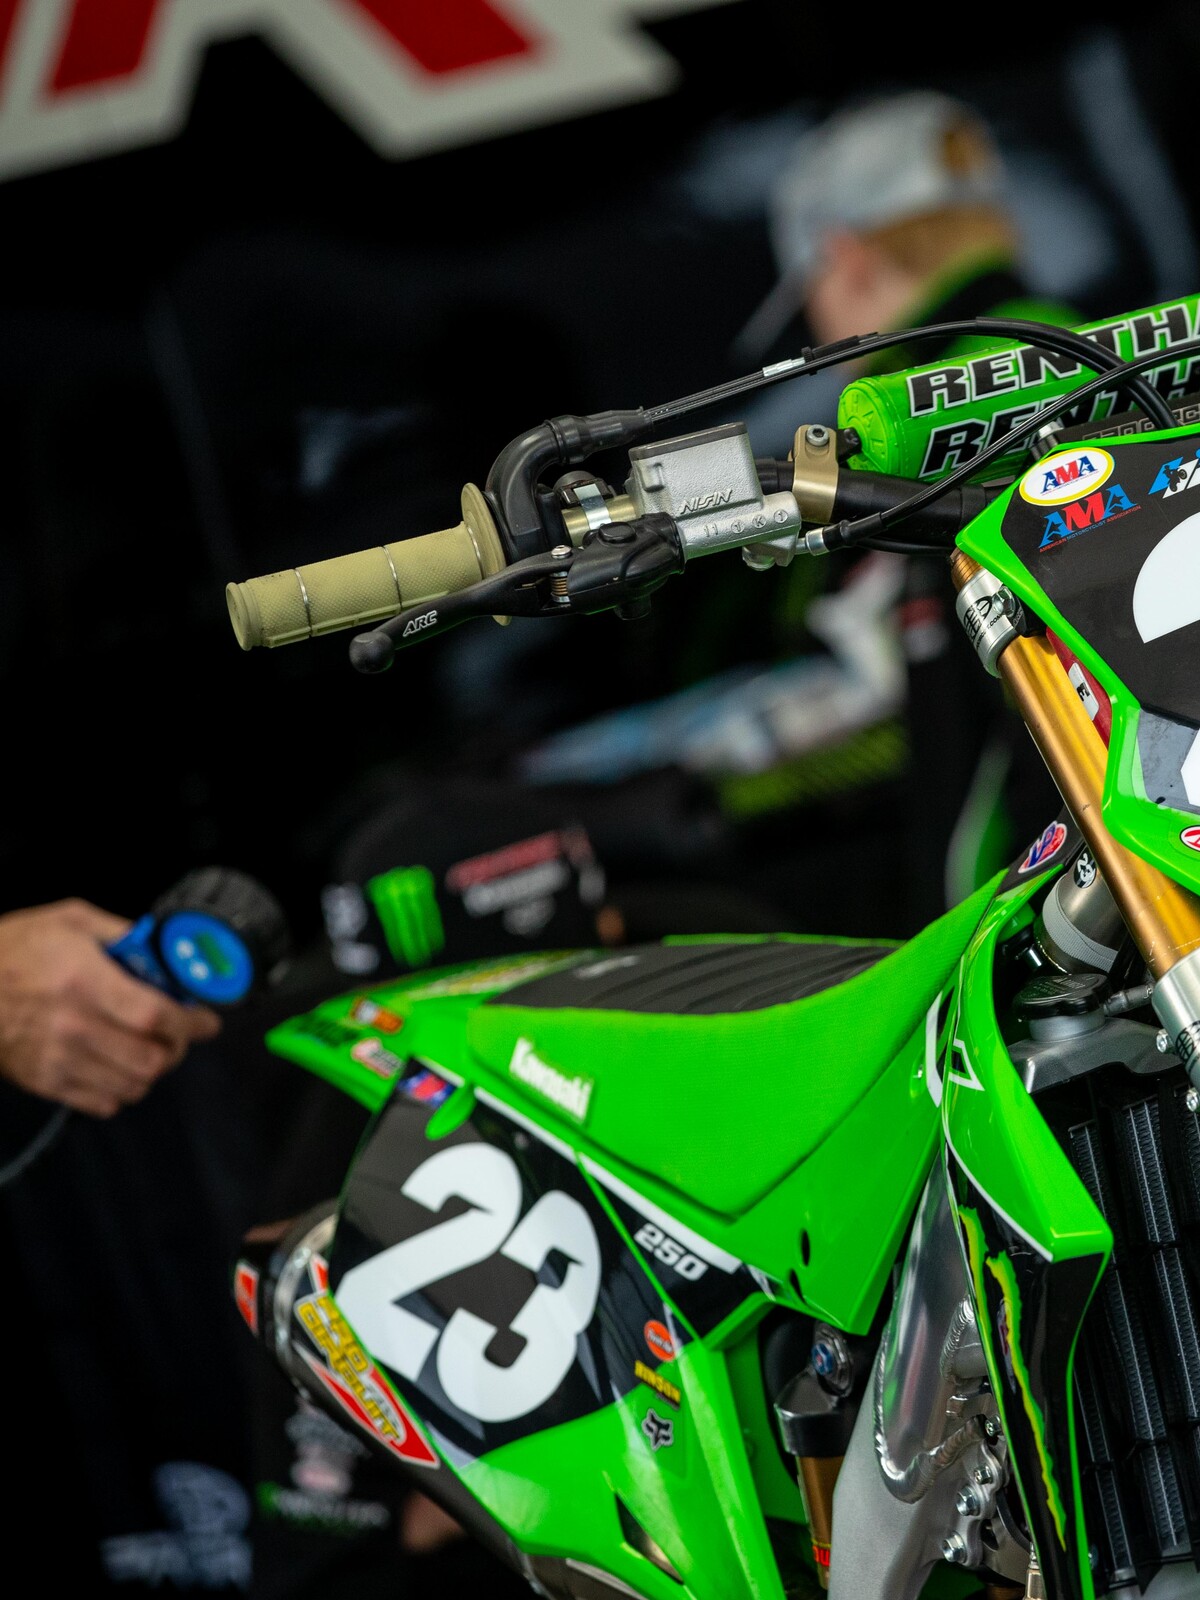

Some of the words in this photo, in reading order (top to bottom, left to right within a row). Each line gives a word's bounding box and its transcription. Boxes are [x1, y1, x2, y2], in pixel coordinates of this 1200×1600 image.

[1041, 456, 1098, 493] AMA
[1038, 484, 1138, 548] AMA
[403, 610, 438, 637] ARC
[633, 1223, 709, 1281] 250
[335, 1141, 600, 1422] 23
